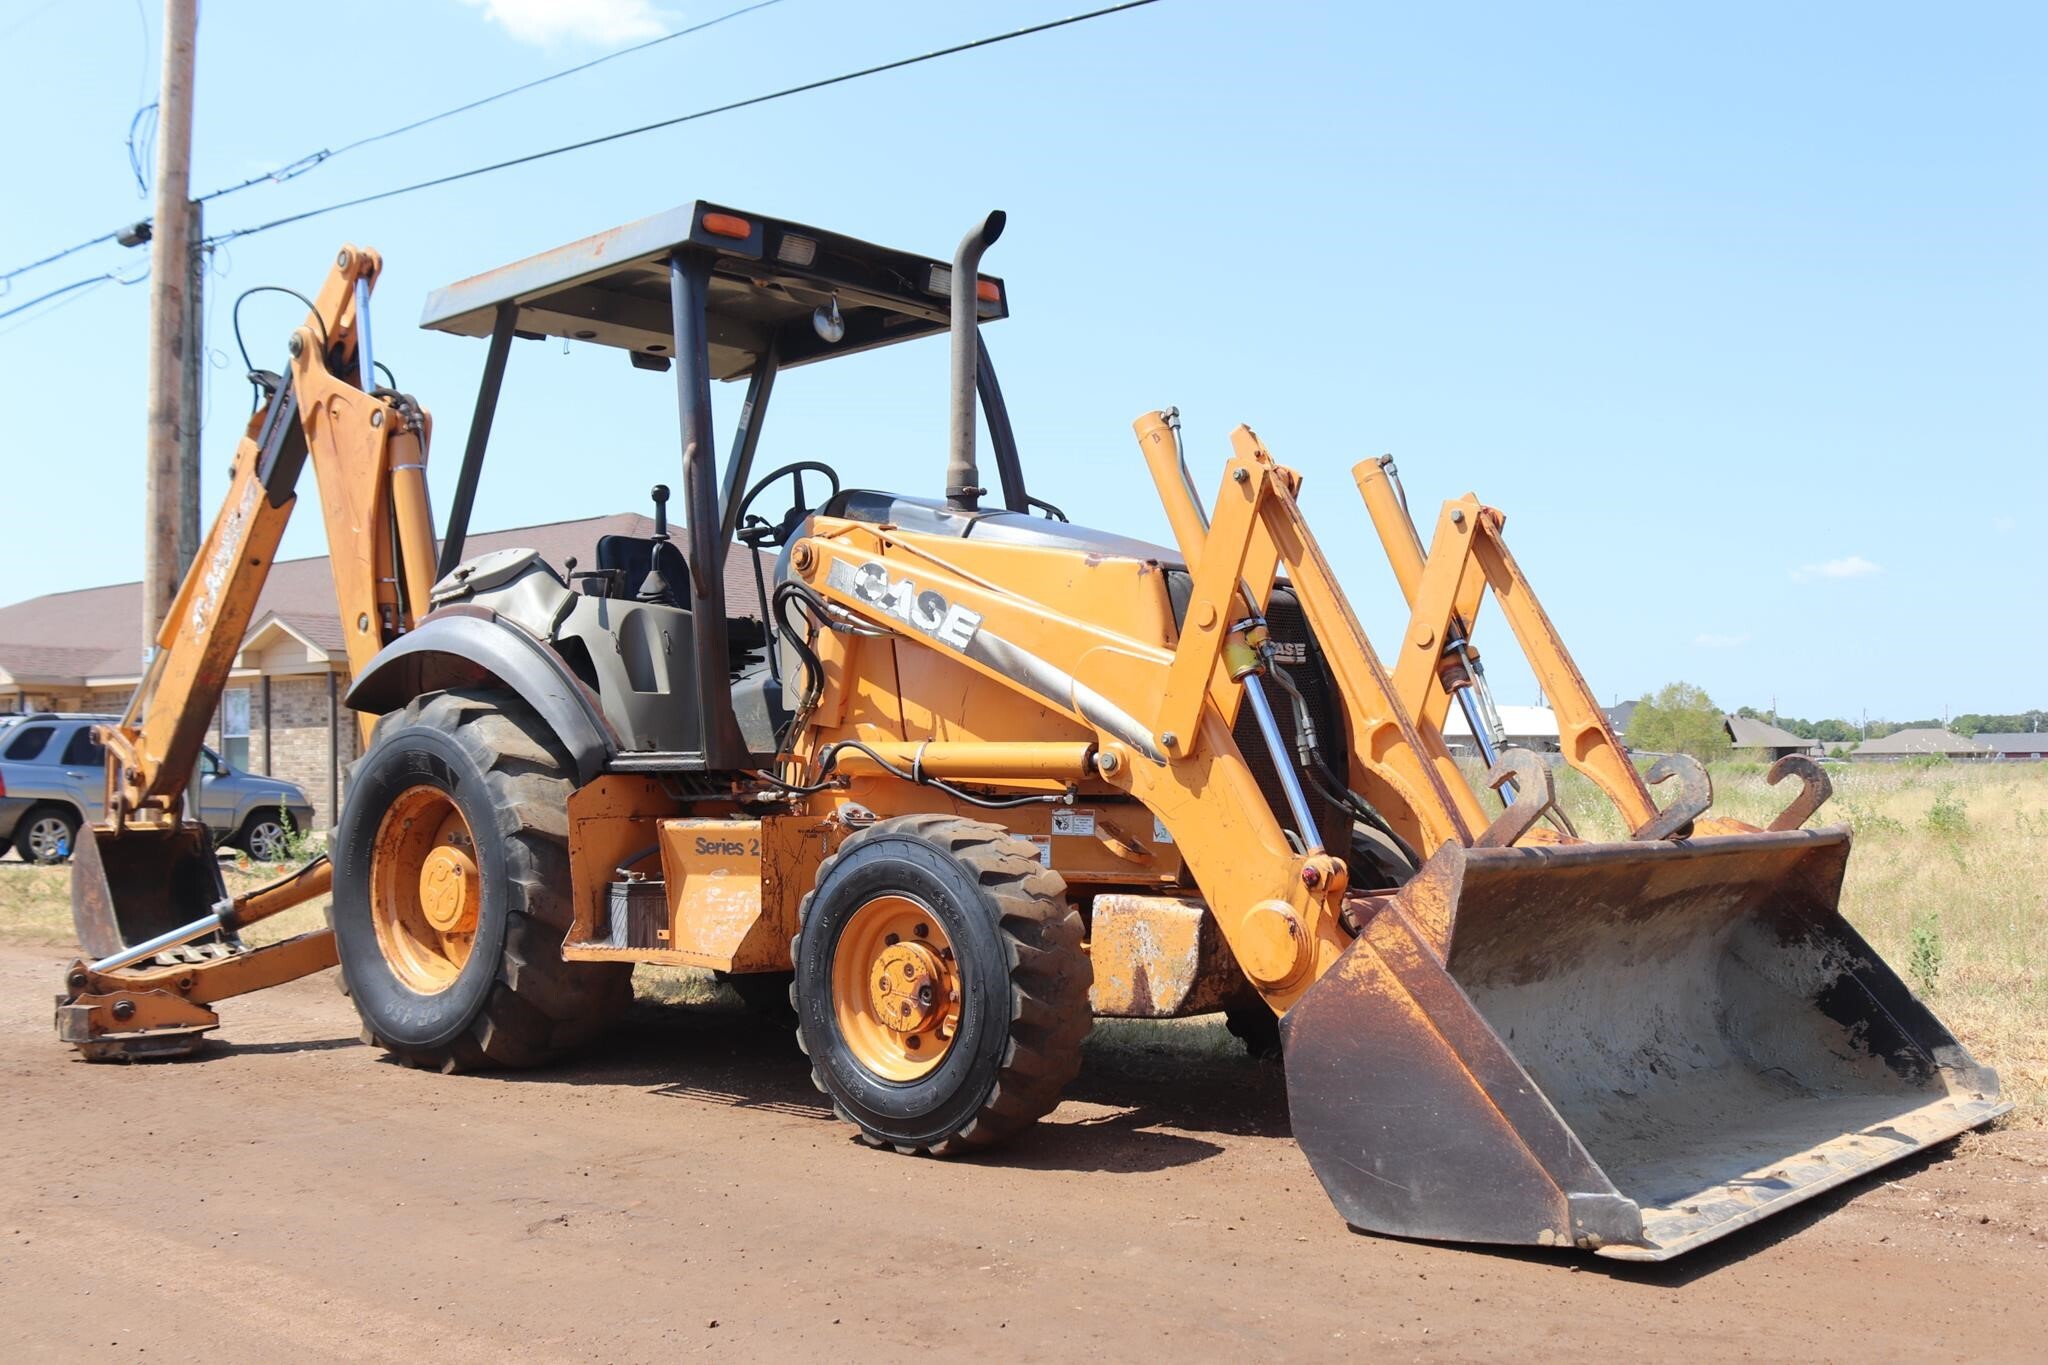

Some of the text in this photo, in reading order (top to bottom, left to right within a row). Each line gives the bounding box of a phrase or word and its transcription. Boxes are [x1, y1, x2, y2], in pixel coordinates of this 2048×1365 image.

[853, 561, 980, 648] CASE
[695, 837, 760, 856] Series 2
